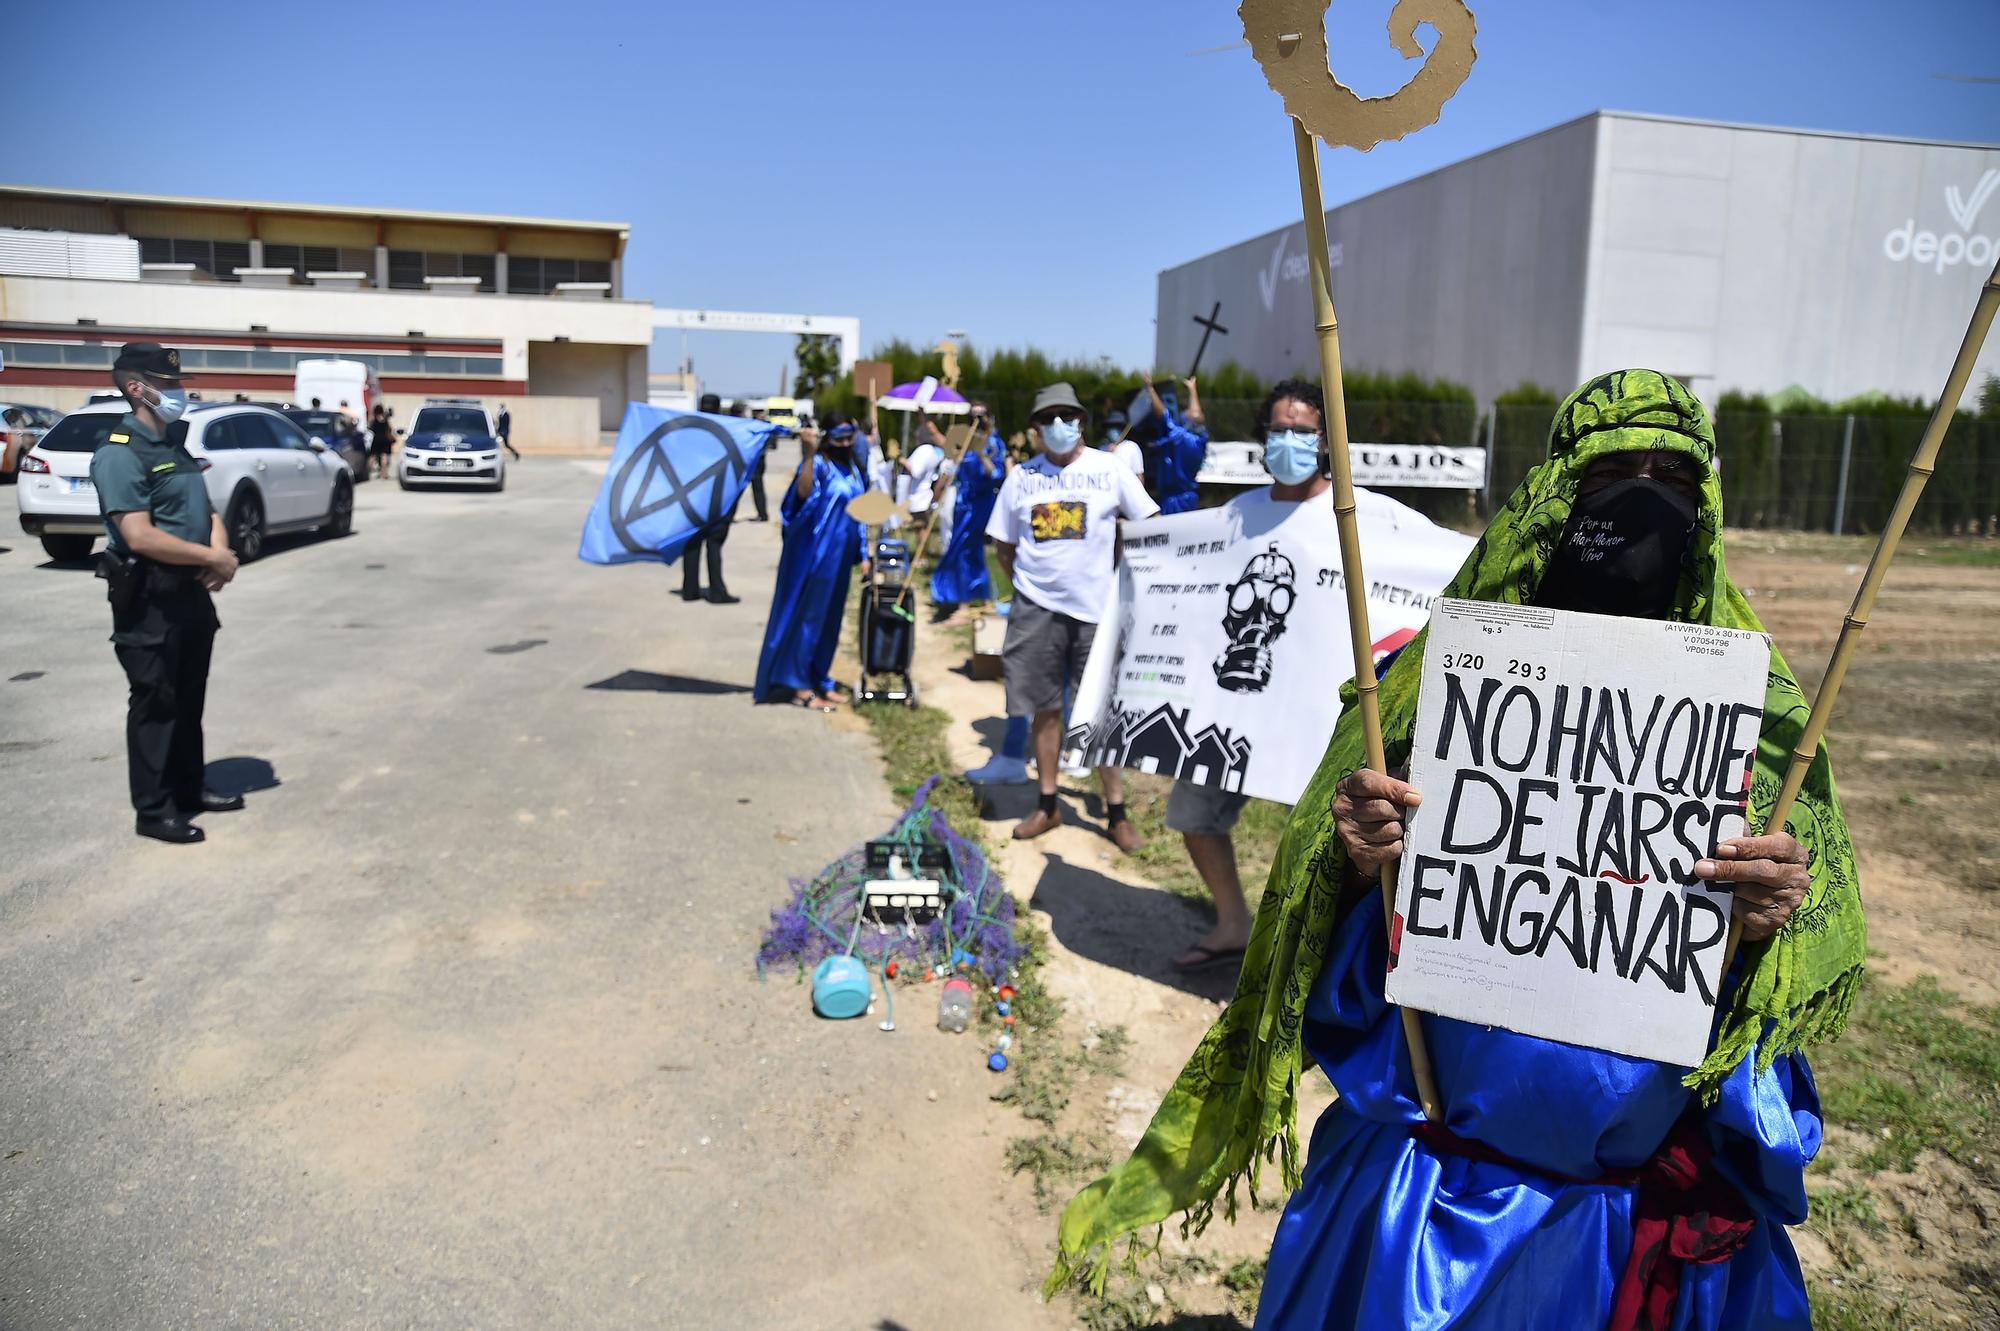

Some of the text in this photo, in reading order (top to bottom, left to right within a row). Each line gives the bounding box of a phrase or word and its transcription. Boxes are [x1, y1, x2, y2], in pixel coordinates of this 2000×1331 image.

[1579, 515, 1599, 530] Por
[1568, 531, 1625, 547] Mar Menor
[1580, 547, 1604, 562] Vivo
[1704, 628, 1714, 636] 50
[1723, 630, 1733, 638] 30
[1742, 632, 1751, 640] 10
[1685, 645, 1725, 656] VP001565
[1435, 672, 1763, 801] NO HAY QUE
